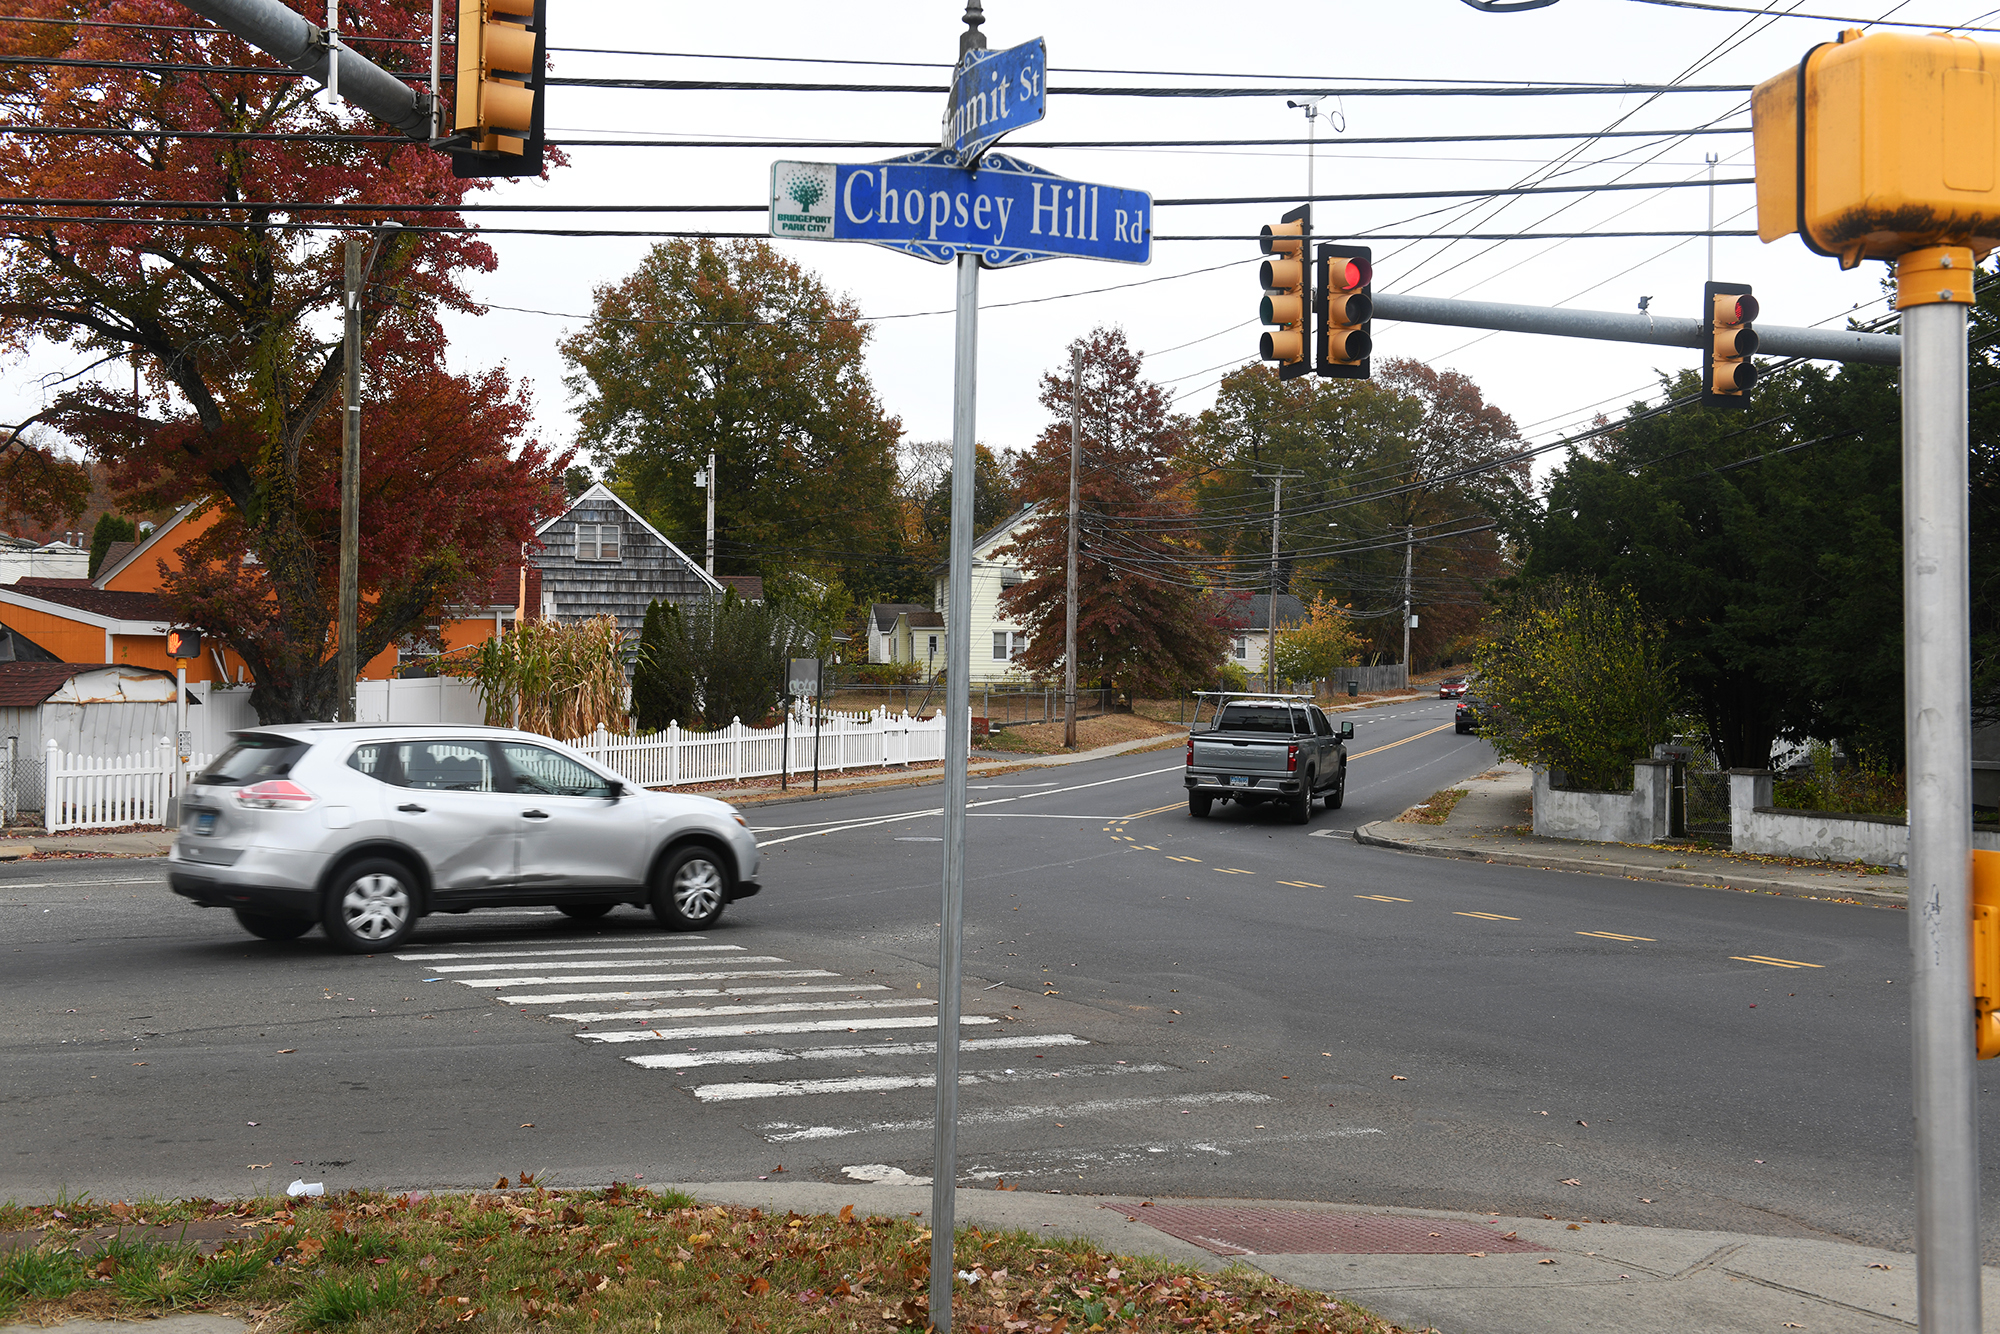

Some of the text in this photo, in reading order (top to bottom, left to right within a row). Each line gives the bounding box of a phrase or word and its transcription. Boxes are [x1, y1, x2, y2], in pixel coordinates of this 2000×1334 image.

[943, 66, 1040, 147] mmit St
[843, 167, 1144, 245] Chopsey Hill Rd
[777, 213, 832, 224] BRIDGEPORT
[782, 222, 827, 233] PARK CITY
[1199, 747, 1282, 758] CHEVROLET
